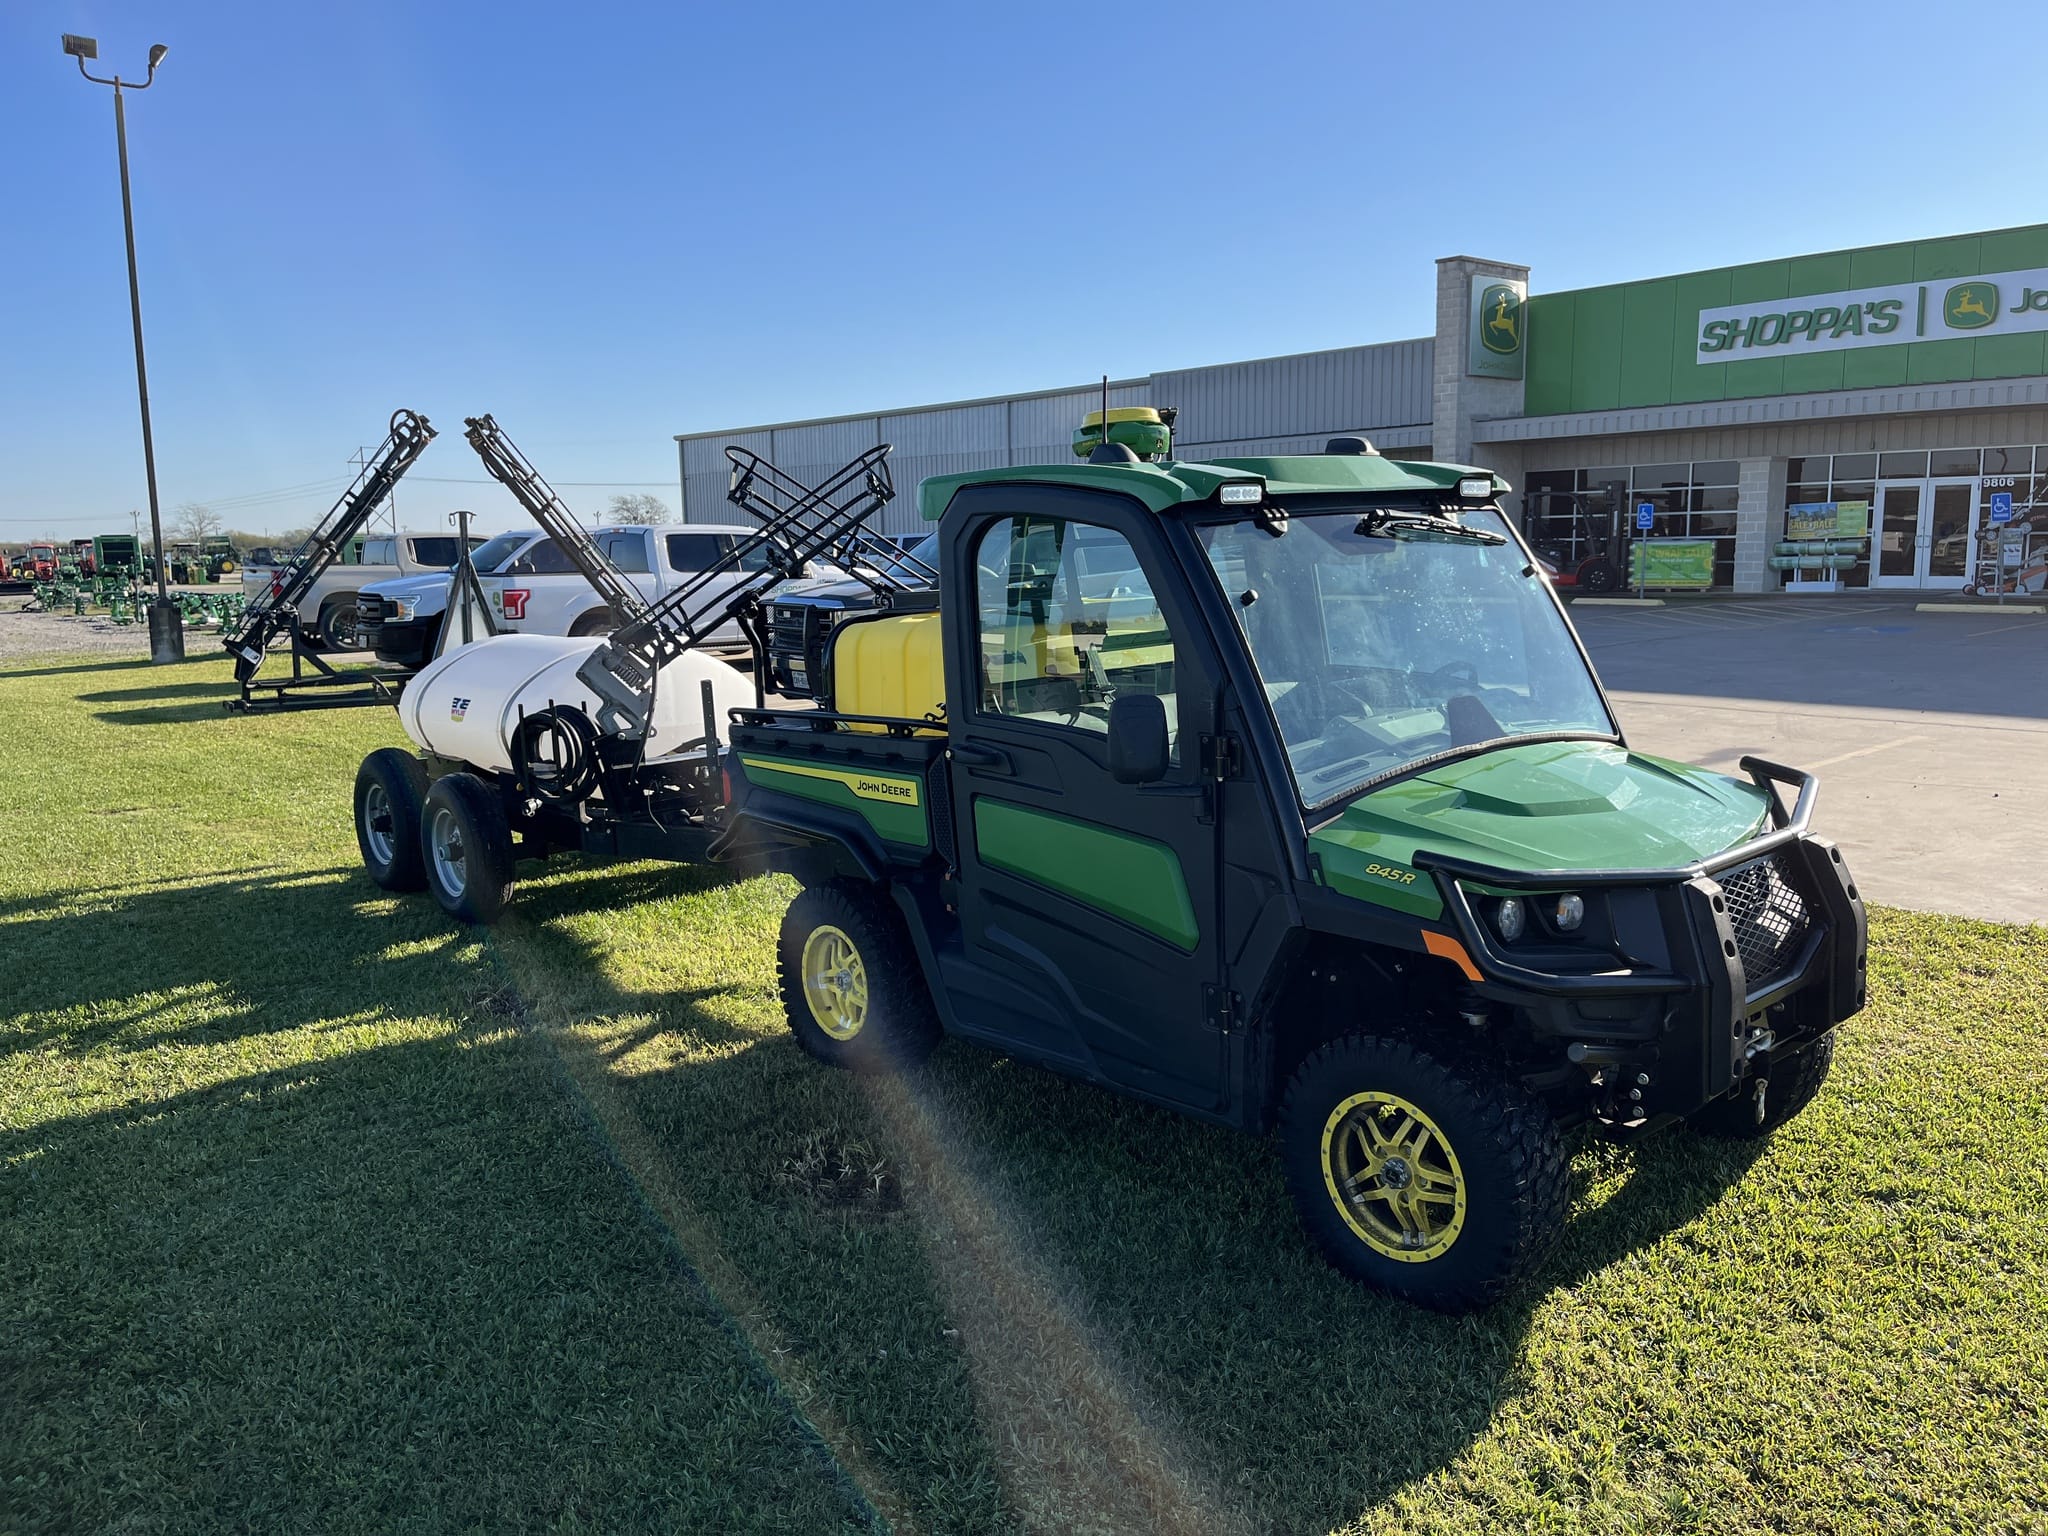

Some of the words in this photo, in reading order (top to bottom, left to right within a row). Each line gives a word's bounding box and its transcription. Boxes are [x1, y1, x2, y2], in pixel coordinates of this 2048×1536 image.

[1699, 300, 1902, 351] SHOPPA'S
[1983, 478, 2015, 488] 9806
[857, 780, 880, 793] JOHN
[881, 783, 911, 797] DEERE
[1365, 863, 1417, 885] 845R
